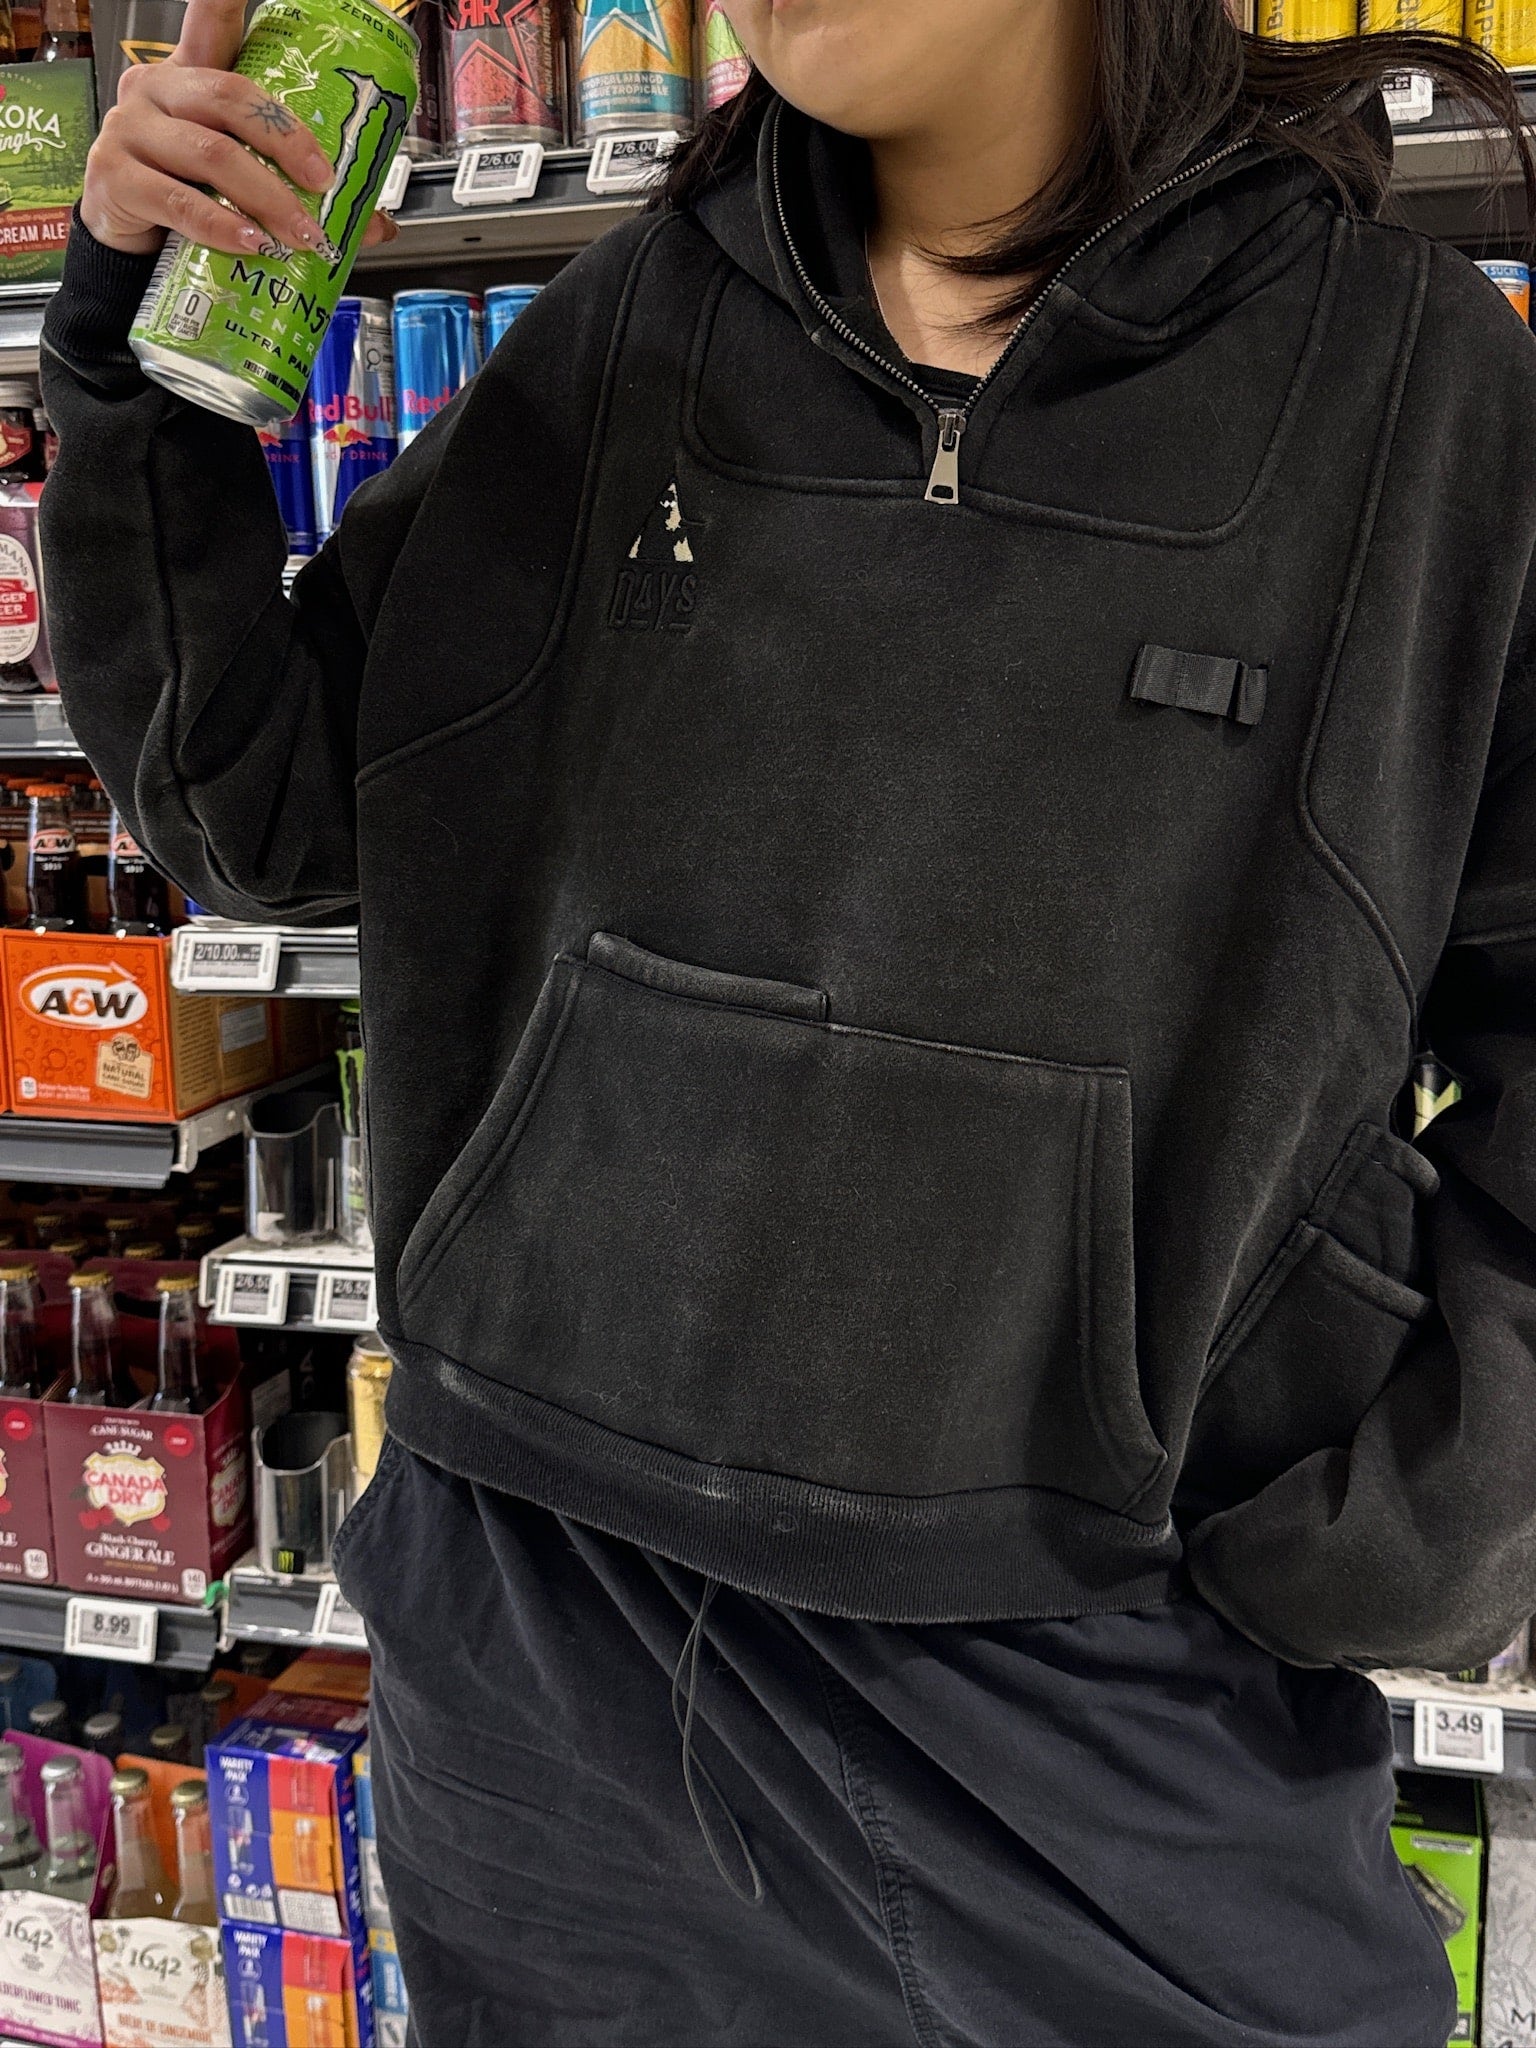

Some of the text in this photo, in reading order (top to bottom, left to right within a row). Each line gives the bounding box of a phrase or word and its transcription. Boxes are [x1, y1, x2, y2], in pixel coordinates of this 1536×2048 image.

[340, 1, 383, 32] ZERO
[541, 6, 553, 106] PUNCH AUX FRUITS
[583, 72, 664, 91] TROPICAL MANGO
[613, 83, 669, 98] TROPICALE
[613, 140, 657, 155] 2/6.00
[480, 152, 522, 167] 2/6.00
[42, 222, 66, 240] ALE
[185, 293, 200, 316] 0
[225, 319, 281, 358] ULTRA
[344, 395, 391, 421] Bull
[350, 450, 388, 461] DRINK
[606, 569, 698, 633] DAYS
[34, 838, 72, 849] A&W
[195, 944, 238, 960] 2/10.00
[38, 986, 138, 1019] A&W
[119, 1425, 154, 1442] SUGAR
[84, 1469, 167, 1494] CANADA
[109, 1487, 145, 1506] DRY
[127, 1535, 158, 1549] Cherry
[84, 1542, 145, 1563] GINGER
[146, 1548, 176, 1567] ALE
[94, 1613, 131, 1635] 8.99
[1436, 1711, 1483, 1734] 3.49
[4, 1915, 54, 1952] 1642
[129, 1942, 182, 1981] 1642
[56, 1994, 82, 2015] TONIC
